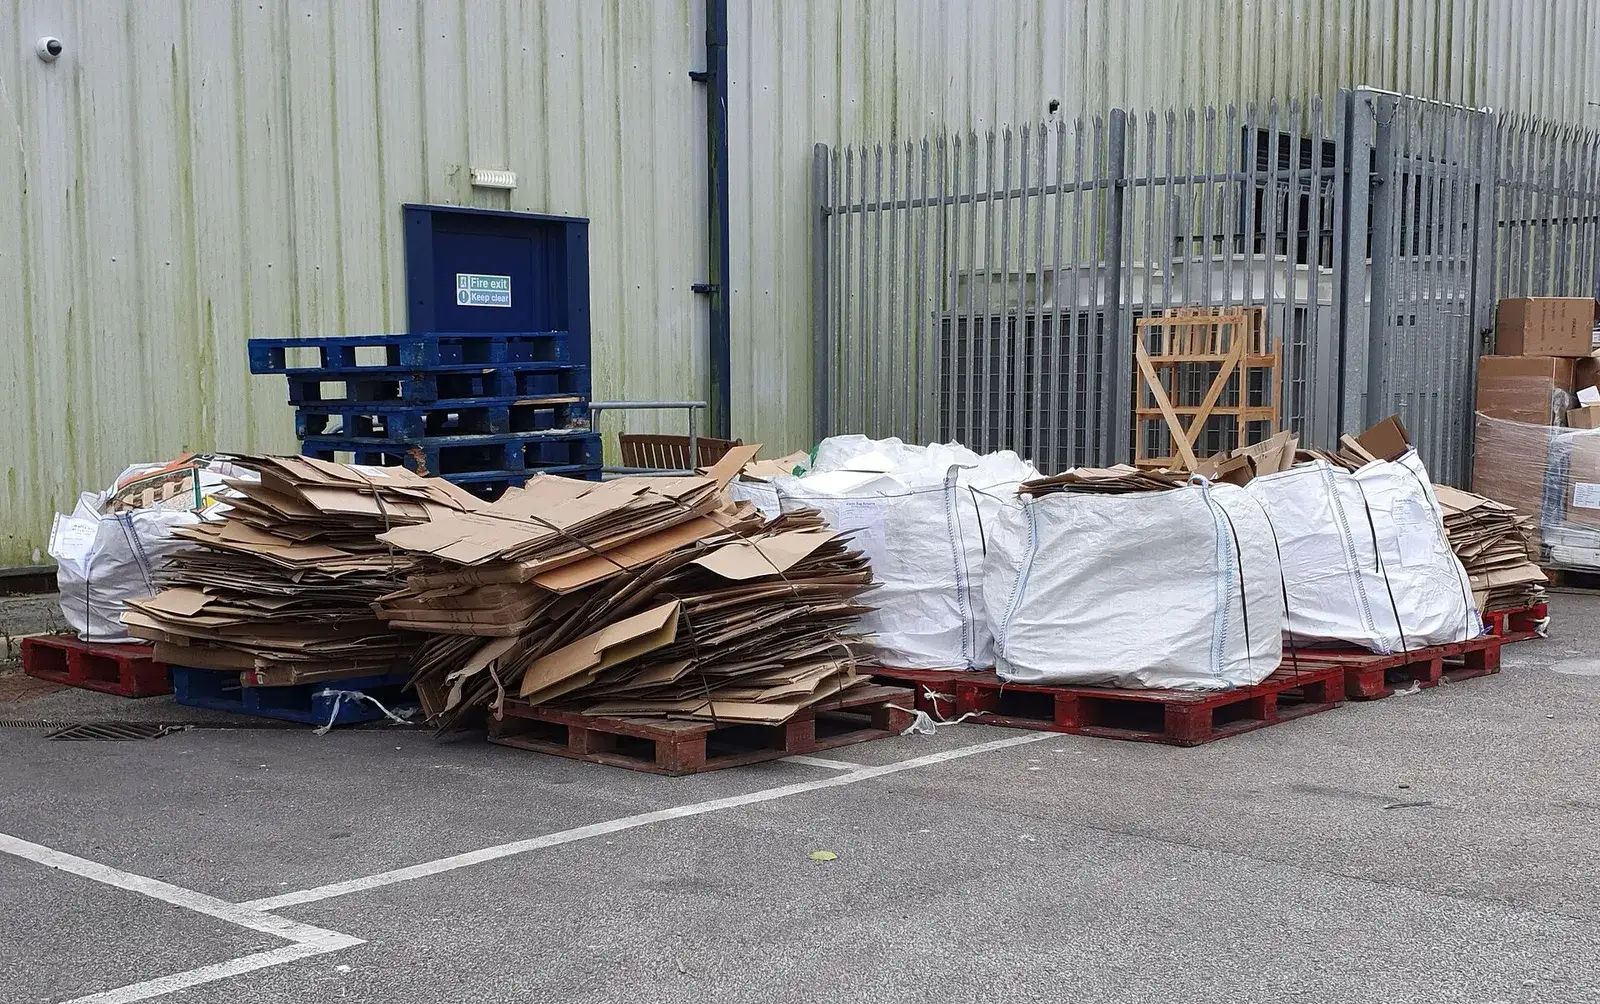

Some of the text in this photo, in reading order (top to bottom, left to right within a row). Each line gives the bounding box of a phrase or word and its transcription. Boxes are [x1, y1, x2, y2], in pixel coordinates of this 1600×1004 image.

[471, 277, 508, 289] Fire exit
[471, 292, 508, 303] Keep clear
